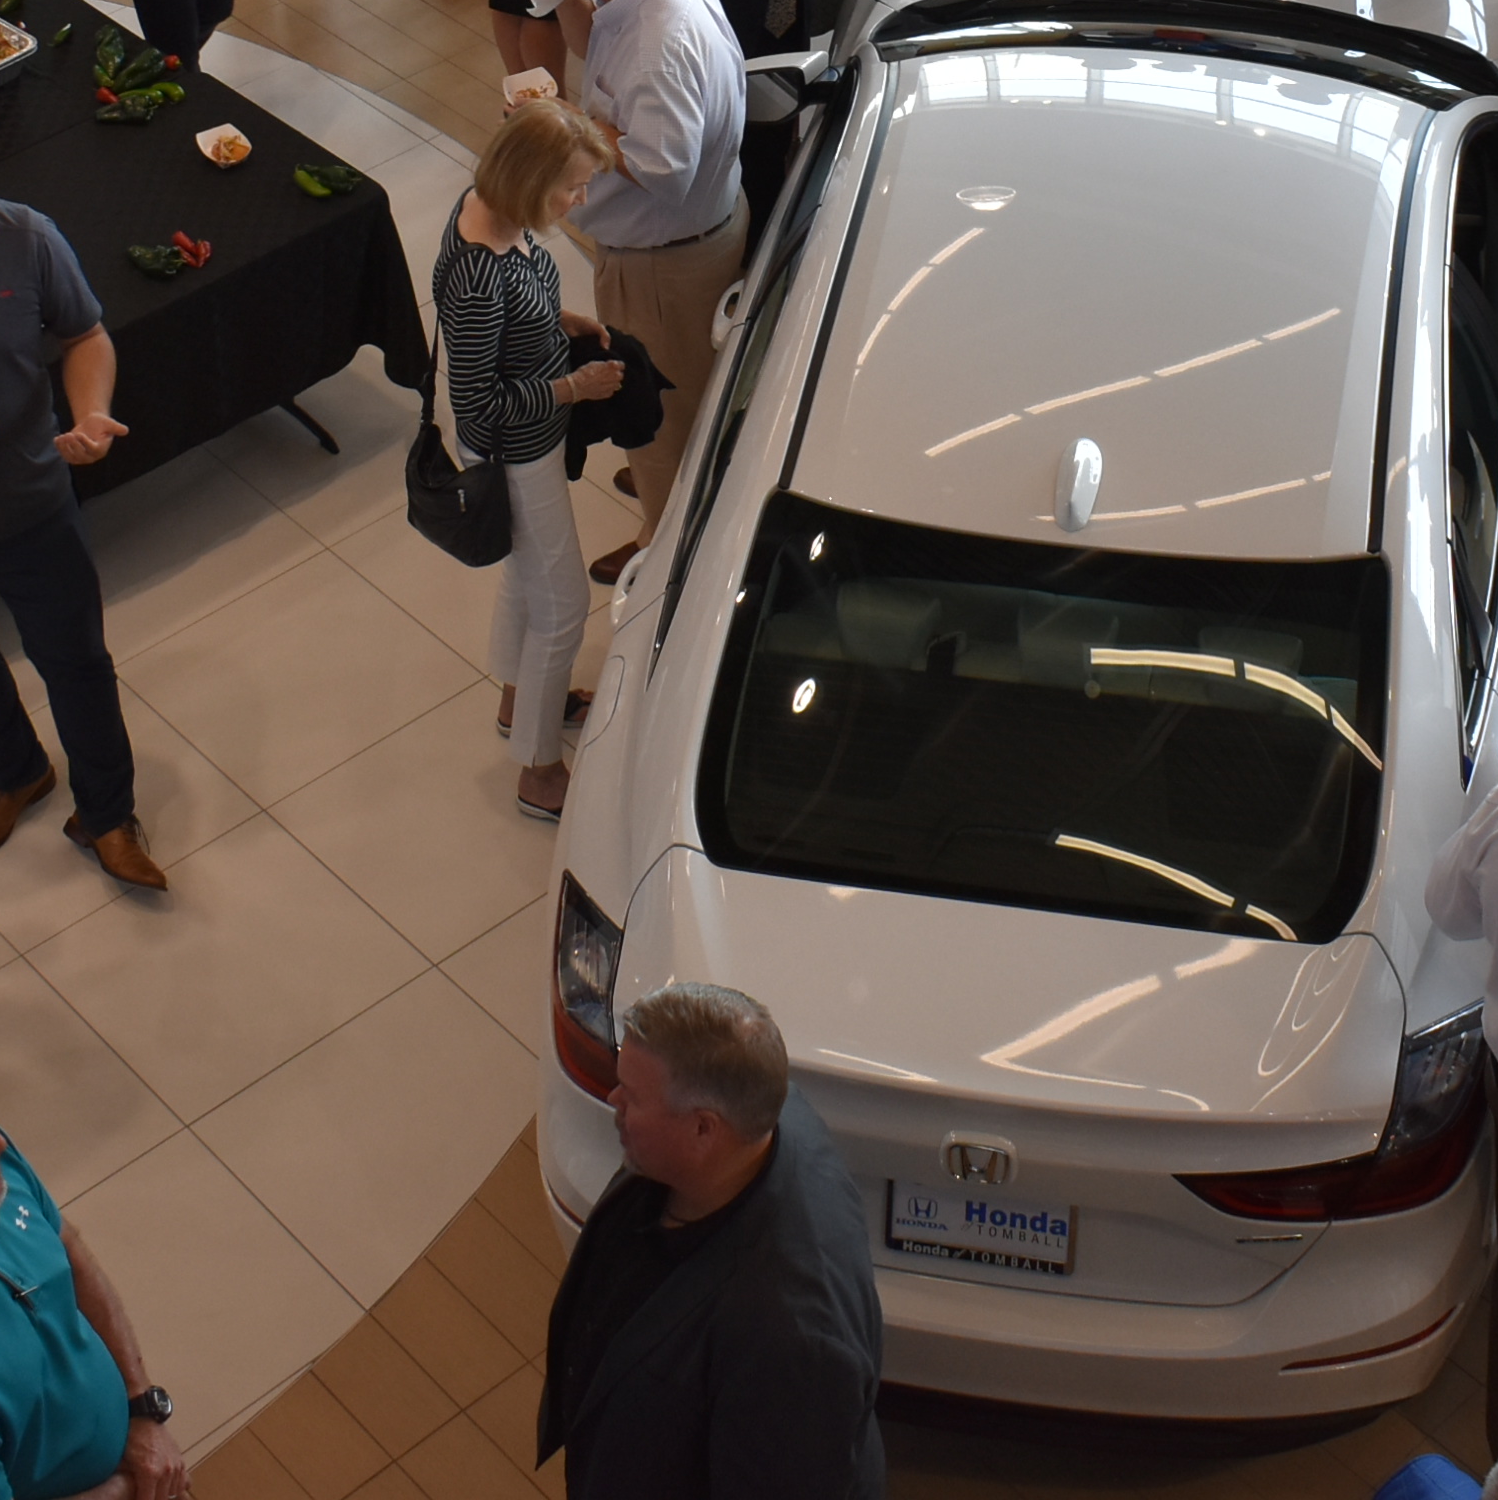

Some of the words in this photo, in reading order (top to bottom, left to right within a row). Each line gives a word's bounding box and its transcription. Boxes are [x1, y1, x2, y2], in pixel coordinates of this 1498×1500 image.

[895, 1216, 949, 1231] HONDA
[965, 1200, 1067, 1237] Honda
[977, 1224, 1064, 1249] TOMBALL
[902, 1239, 949, 1258] Honda
[970, 1251, 1056, 1274] TOMBALL
